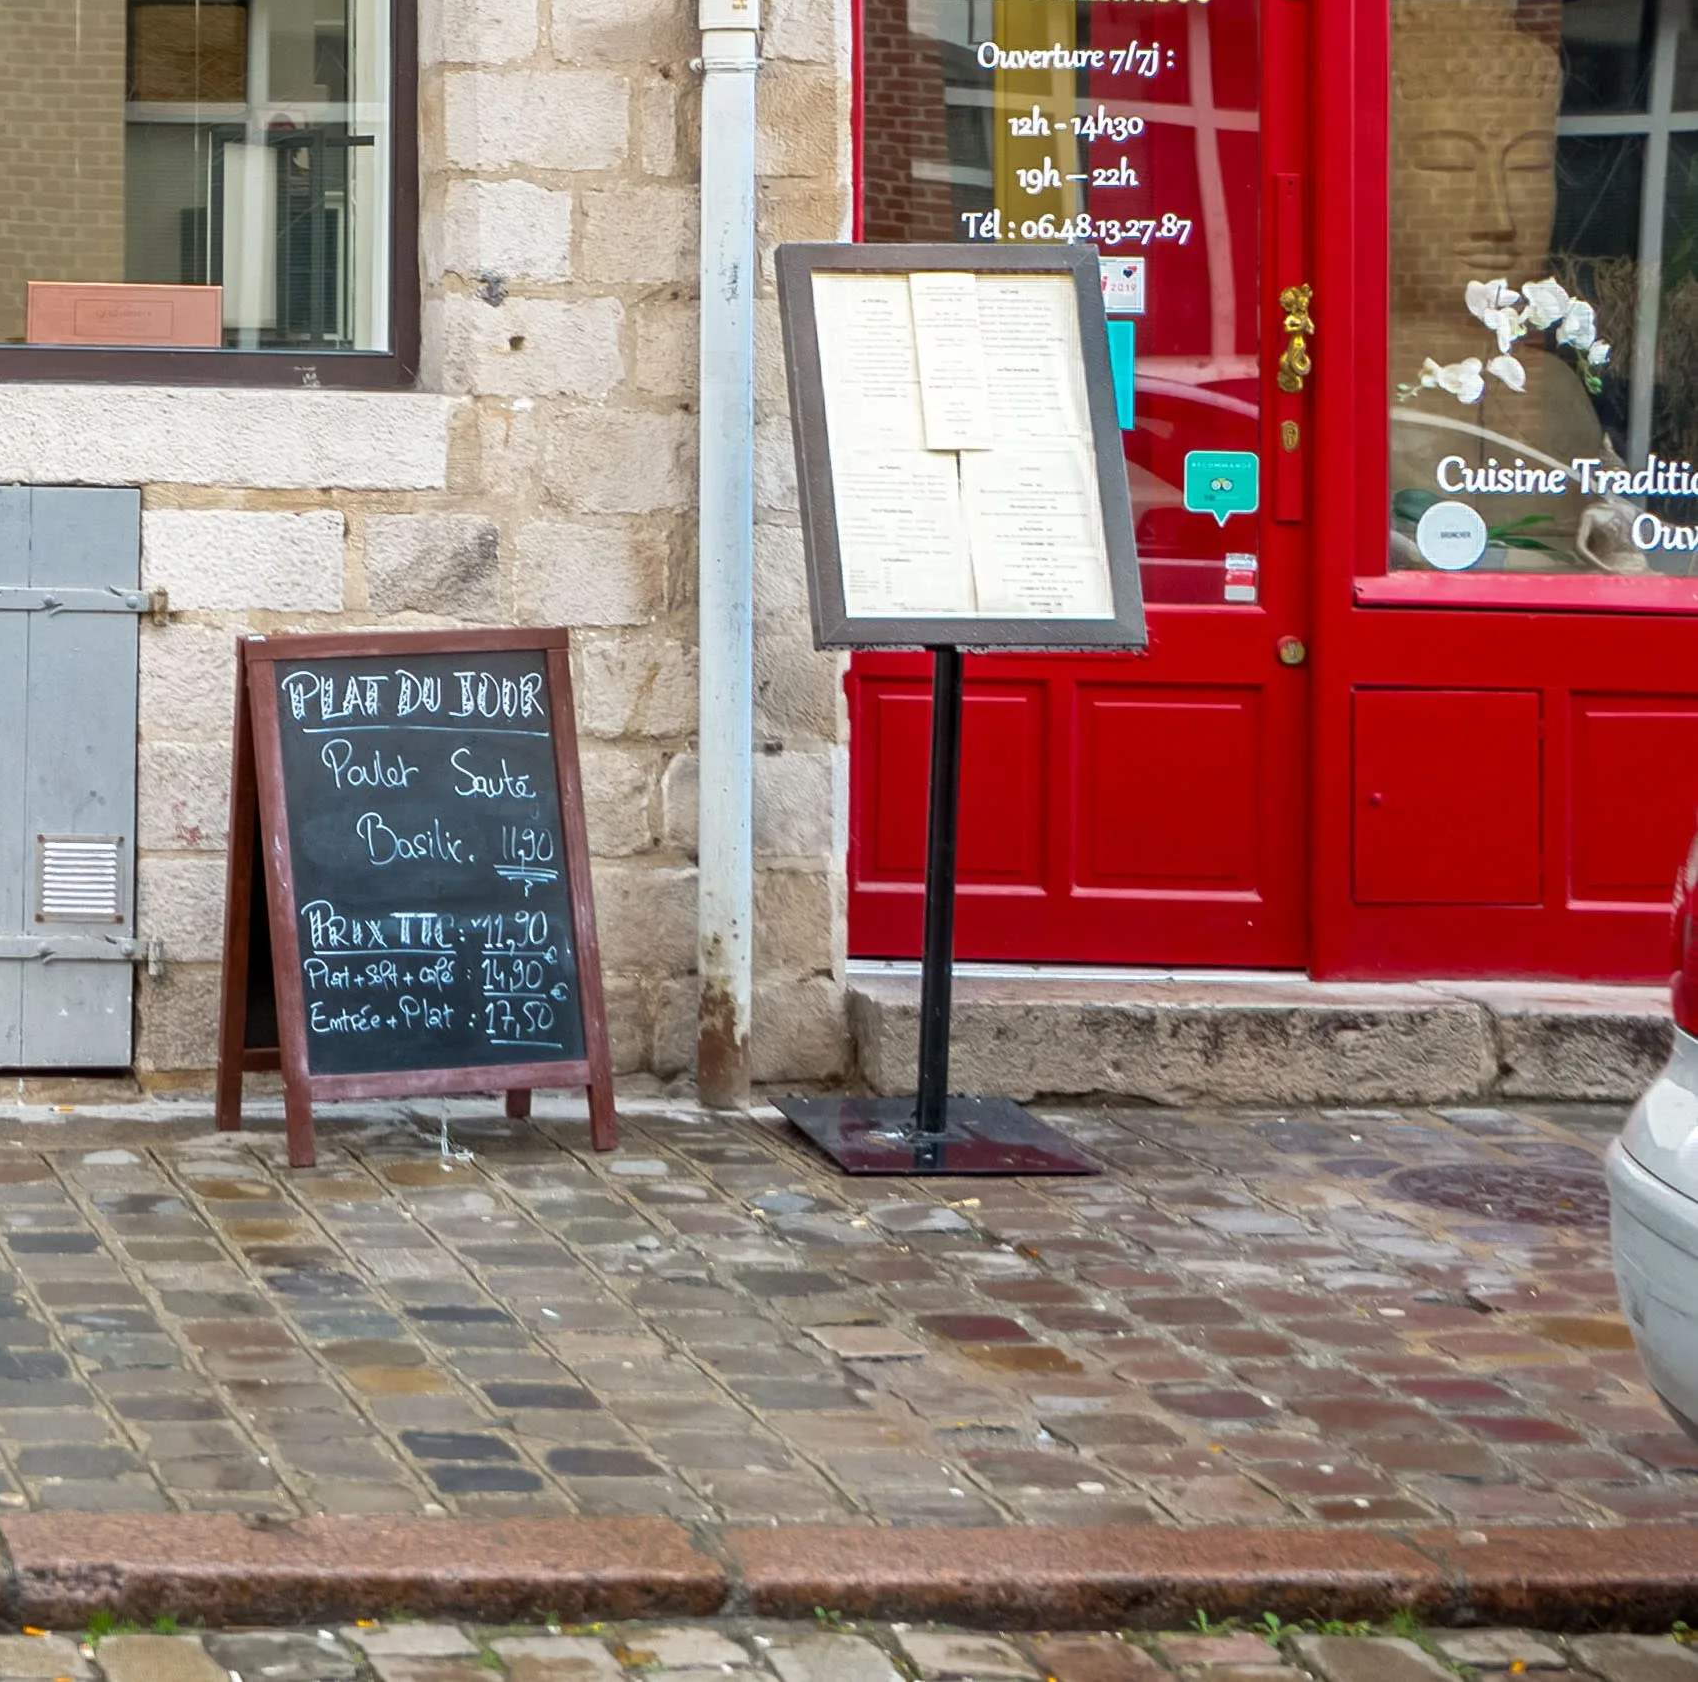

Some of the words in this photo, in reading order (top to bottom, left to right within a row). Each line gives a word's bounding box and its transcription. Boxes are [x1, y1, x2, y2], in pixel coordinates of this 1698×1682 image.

[977, 41, 1104, 70] Ouverture
[1108, 40, 1161, 78] 7/7j
[1009, 105, 1050, 137] 12h
[1071, 105, 1144, 142] 14h30
[1016, 156, 1061, 195] 19h
[1092, 156, 1138, 188] 22h
[960, 212, 1003, 240] Tél
[1020, 214, 1193, 247] 06.48.13.27.87
[1437, 456, 1566, 494] Cuisine
[1631, 514, 1698, 552] Ouv
[282, 670, 387, 720] PLAT
[395, 669, 442, 716] DU
[448, 670, 545, 719] JOUR
[322, 739, 419, 790] Poulet
[451, 748, 536, 799] Sauté
[501, 825, 555, 874] 11,90
[301, 900, 386, 949] PRIX
[304, 958, 348, 990] Plat
[311, 1003, 382, 1034] Entrée
[400, 995, 454, 1032] Plat
[483, 999, 555, 1041] 17,50
